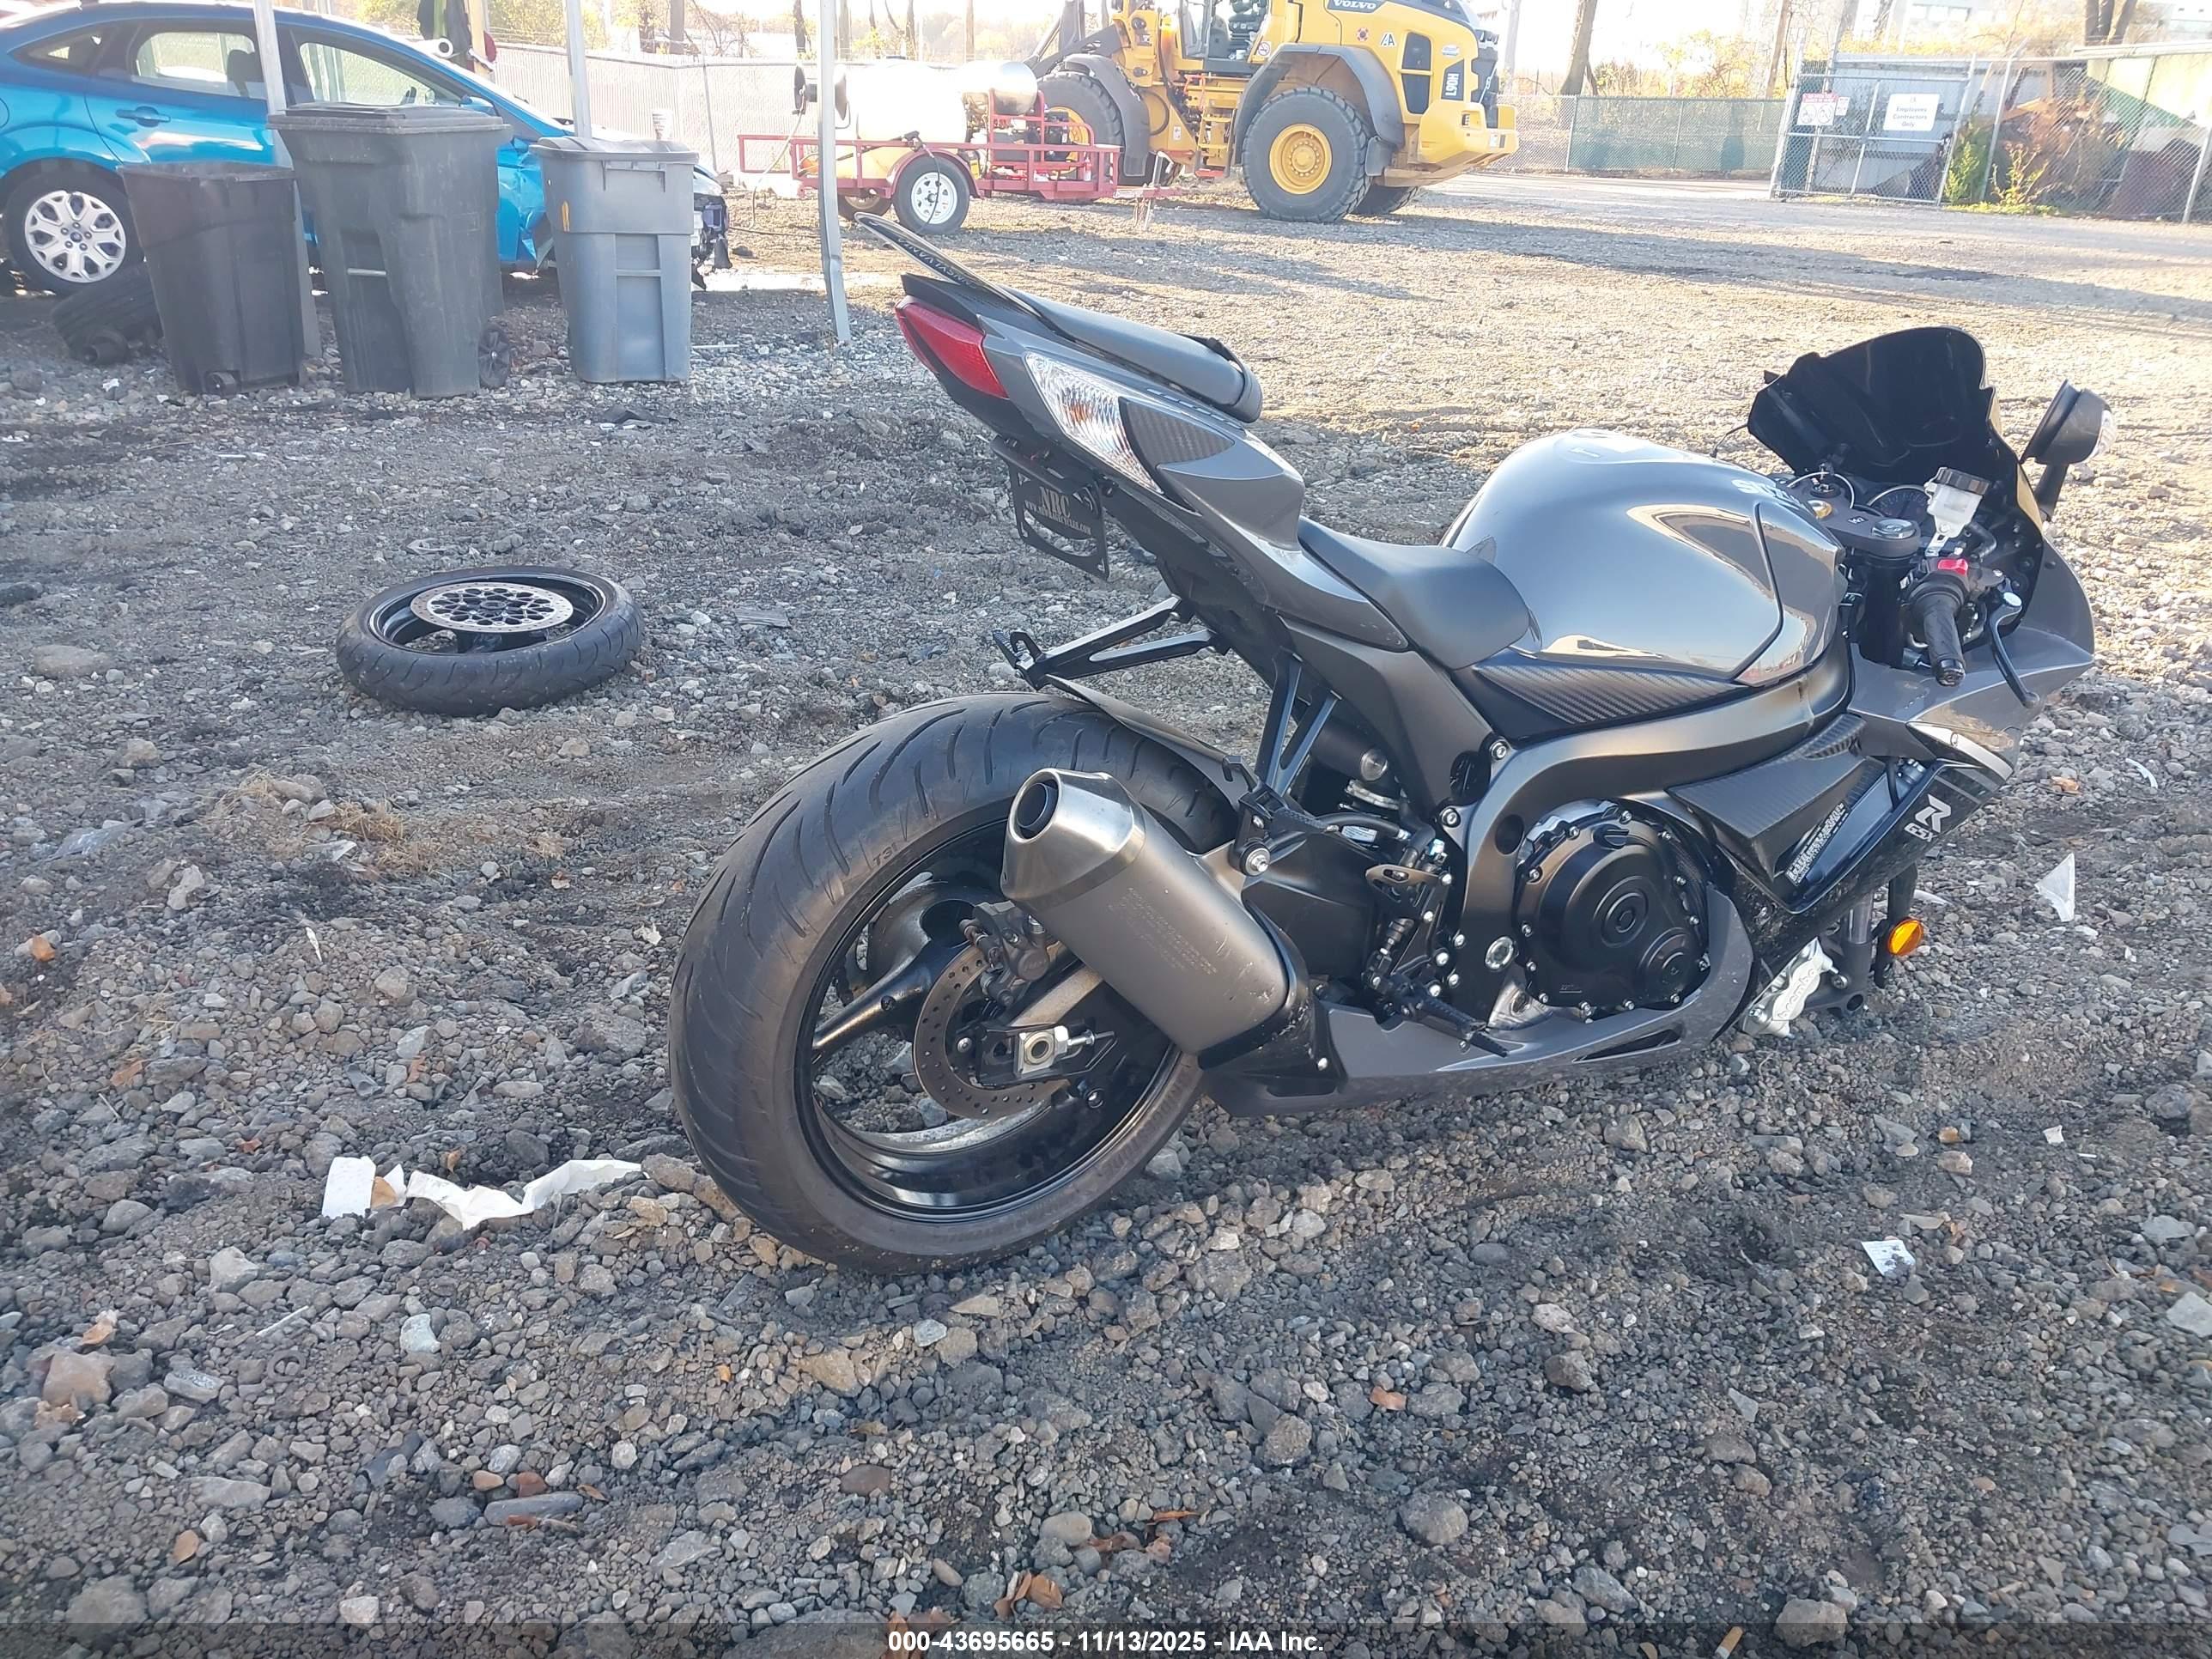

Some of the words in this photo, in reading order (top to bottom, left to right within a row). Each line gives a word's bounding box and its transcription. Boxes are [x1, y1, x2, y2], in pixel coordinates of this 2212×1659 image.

[1334, 0, 1376, 9] VOLVO
[1445, 73, 1460, 96] L90H
[1039, 486, 1071, 519] NRC
[1904, 822, 1938, 842] GSX
[872, 842, 898, 866] T31
[1777, 967, 1818, 1022] brembo
